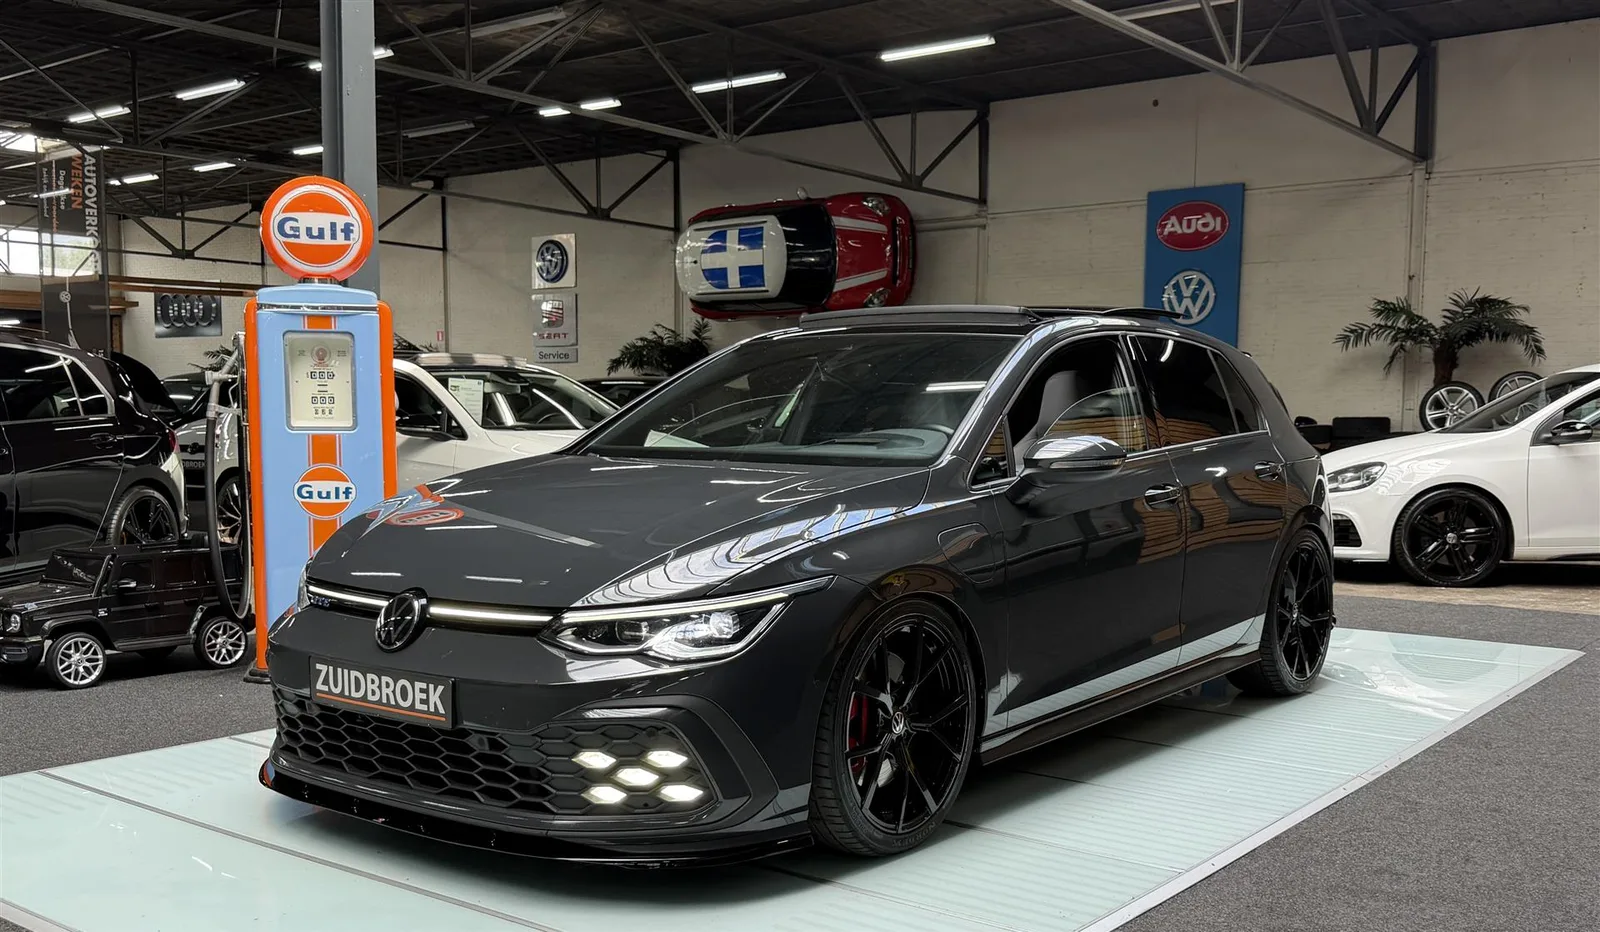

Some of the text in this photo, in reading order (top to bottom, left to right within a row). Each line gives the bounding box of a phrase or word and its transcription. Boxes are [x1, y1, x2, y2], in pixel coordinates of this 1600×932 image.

[72, 153, 83, 209] WEKEN
[277, 216, 354, 241] Gulf
[538, 332, 569, 340] SEAT
[538, 350, 570, 360] Service
[296, 484, 353, 499] Gulf
[316, 663, 446, 714] ZUIDBROEK
